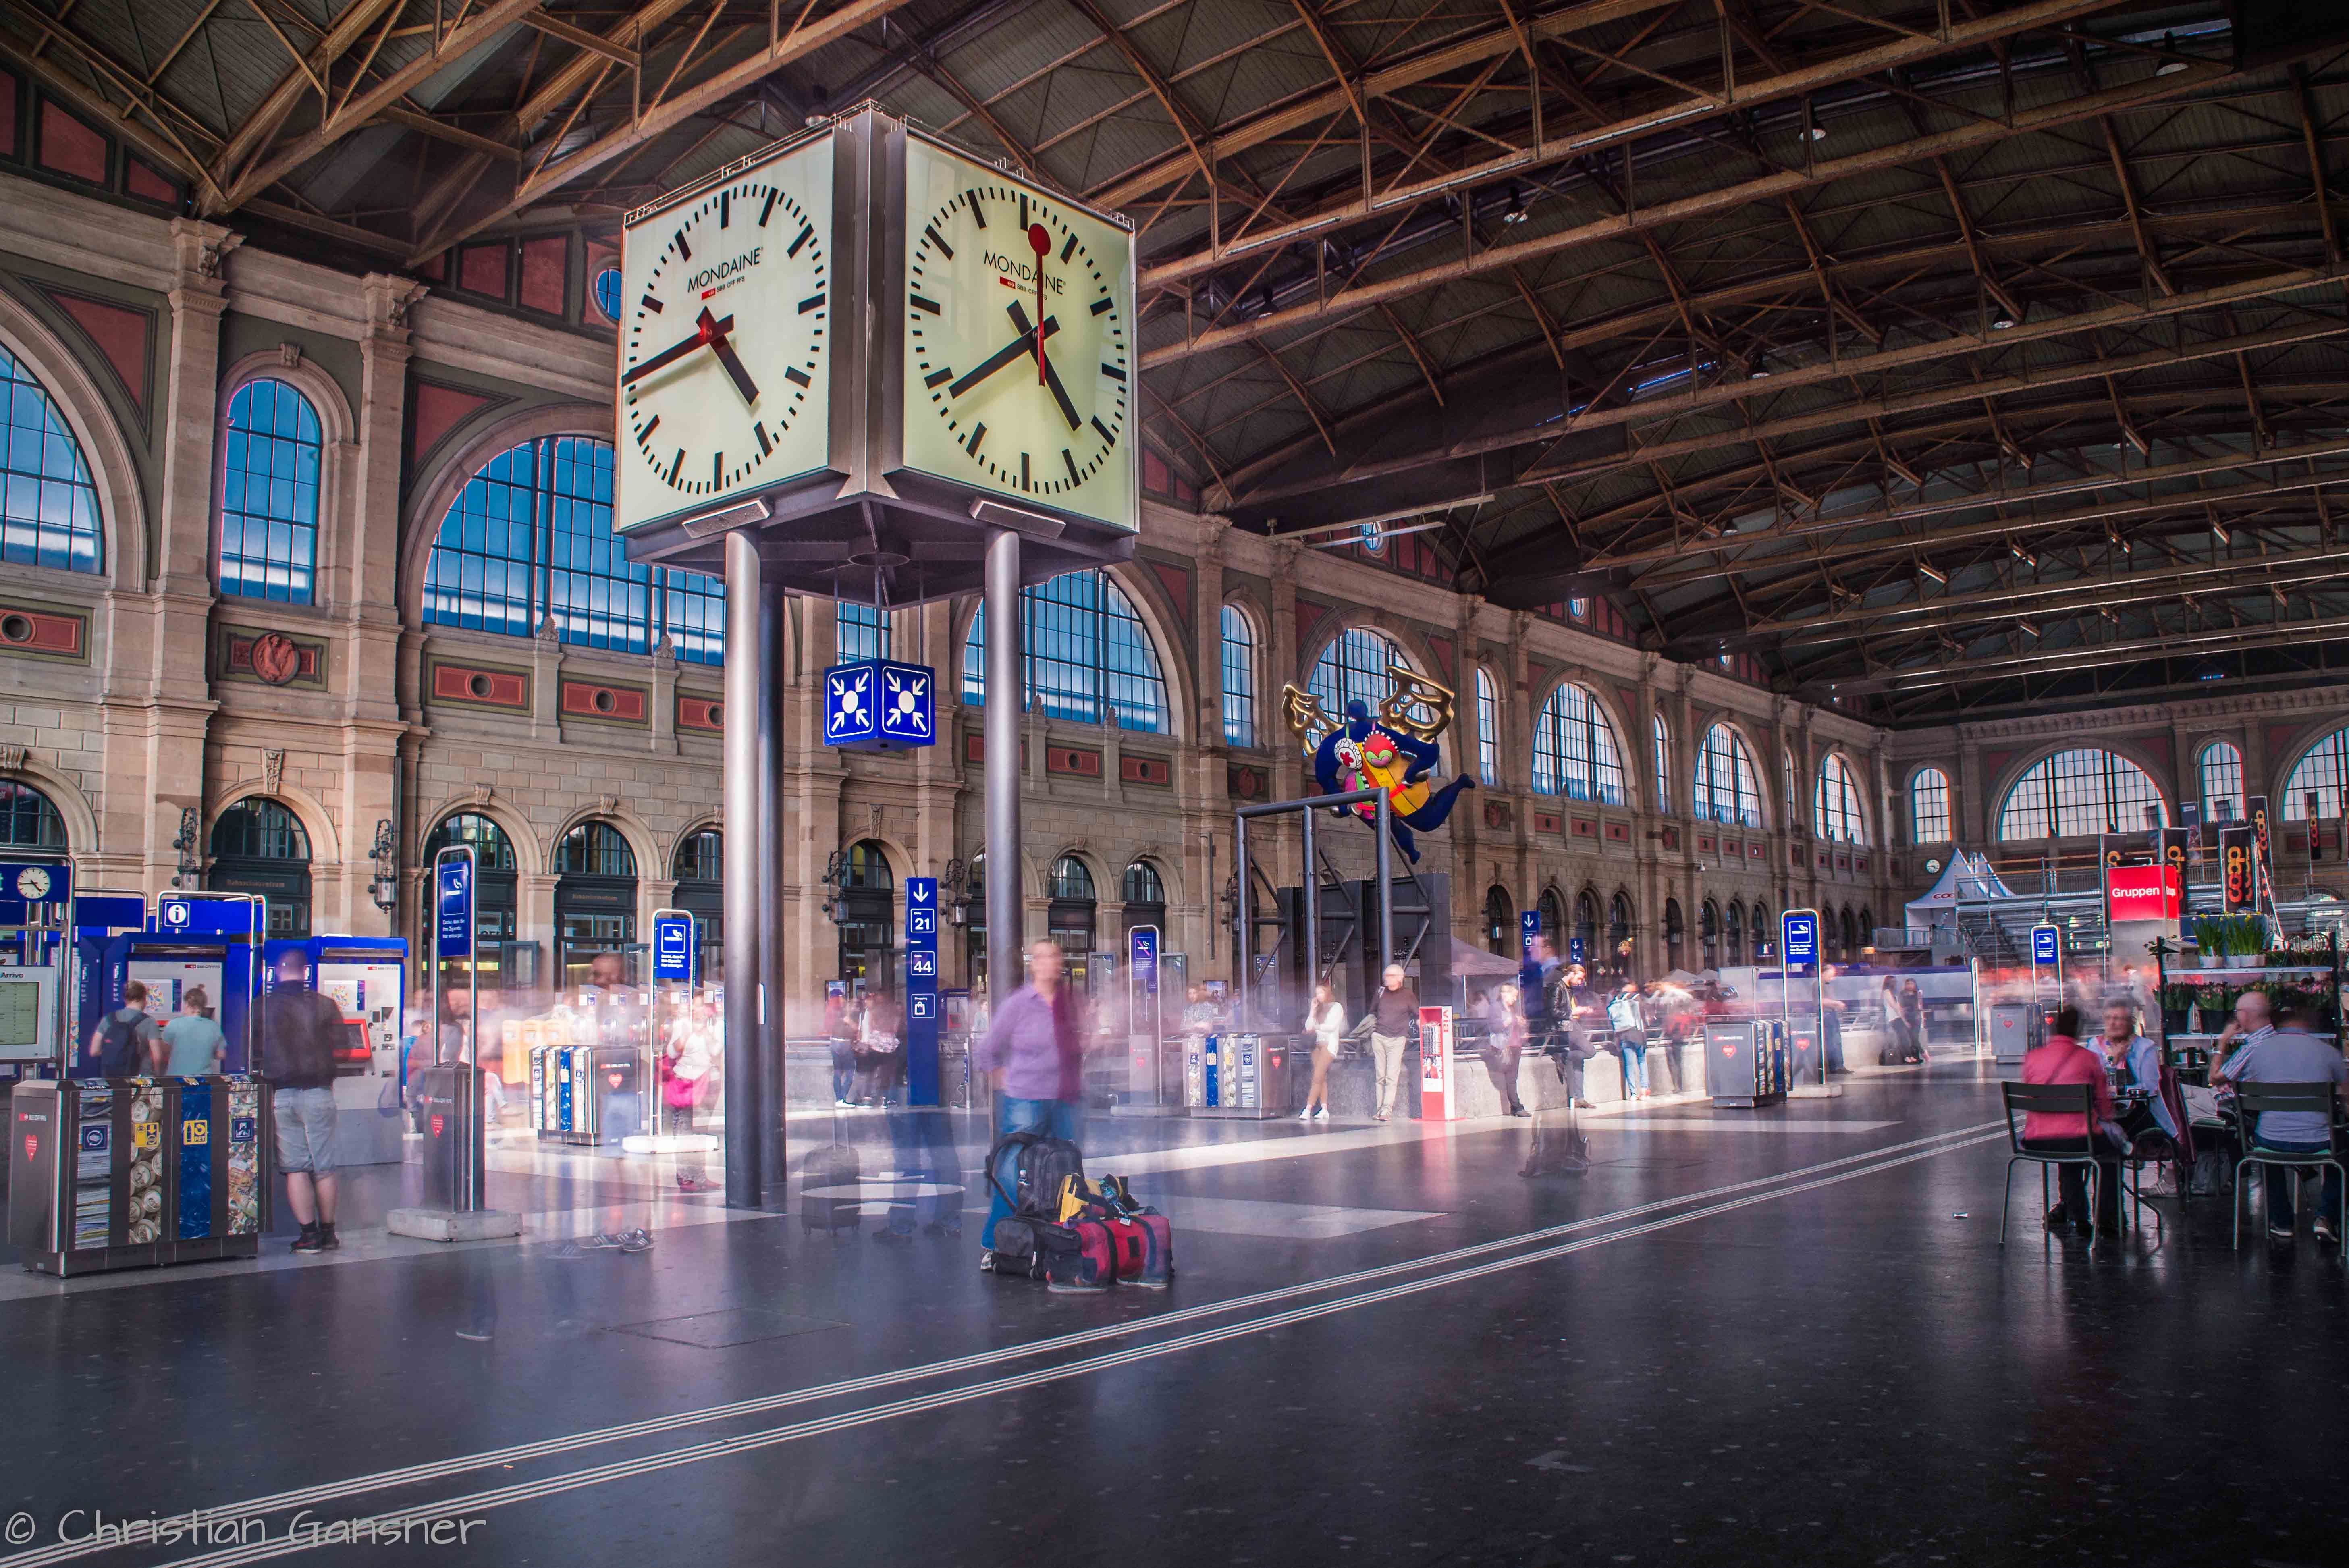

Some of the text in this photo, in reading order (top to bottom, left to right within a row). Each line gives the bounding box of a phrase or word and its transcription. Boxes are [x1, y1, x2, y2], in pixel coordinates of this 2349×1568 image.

[687, 246, 761, 293] MONDAINE
[717, 275, 745, 292] SBB CFF FFS
[1017, 284, 1027, 292] SBB
[2254, 810, 2268, 851] coop
[2228, 846, 2245, 903] coop
[2112, 887, 2160, 899] Gruppen
[915, 918, 930, 930] 21
[913, 960, 933, 972] 44
